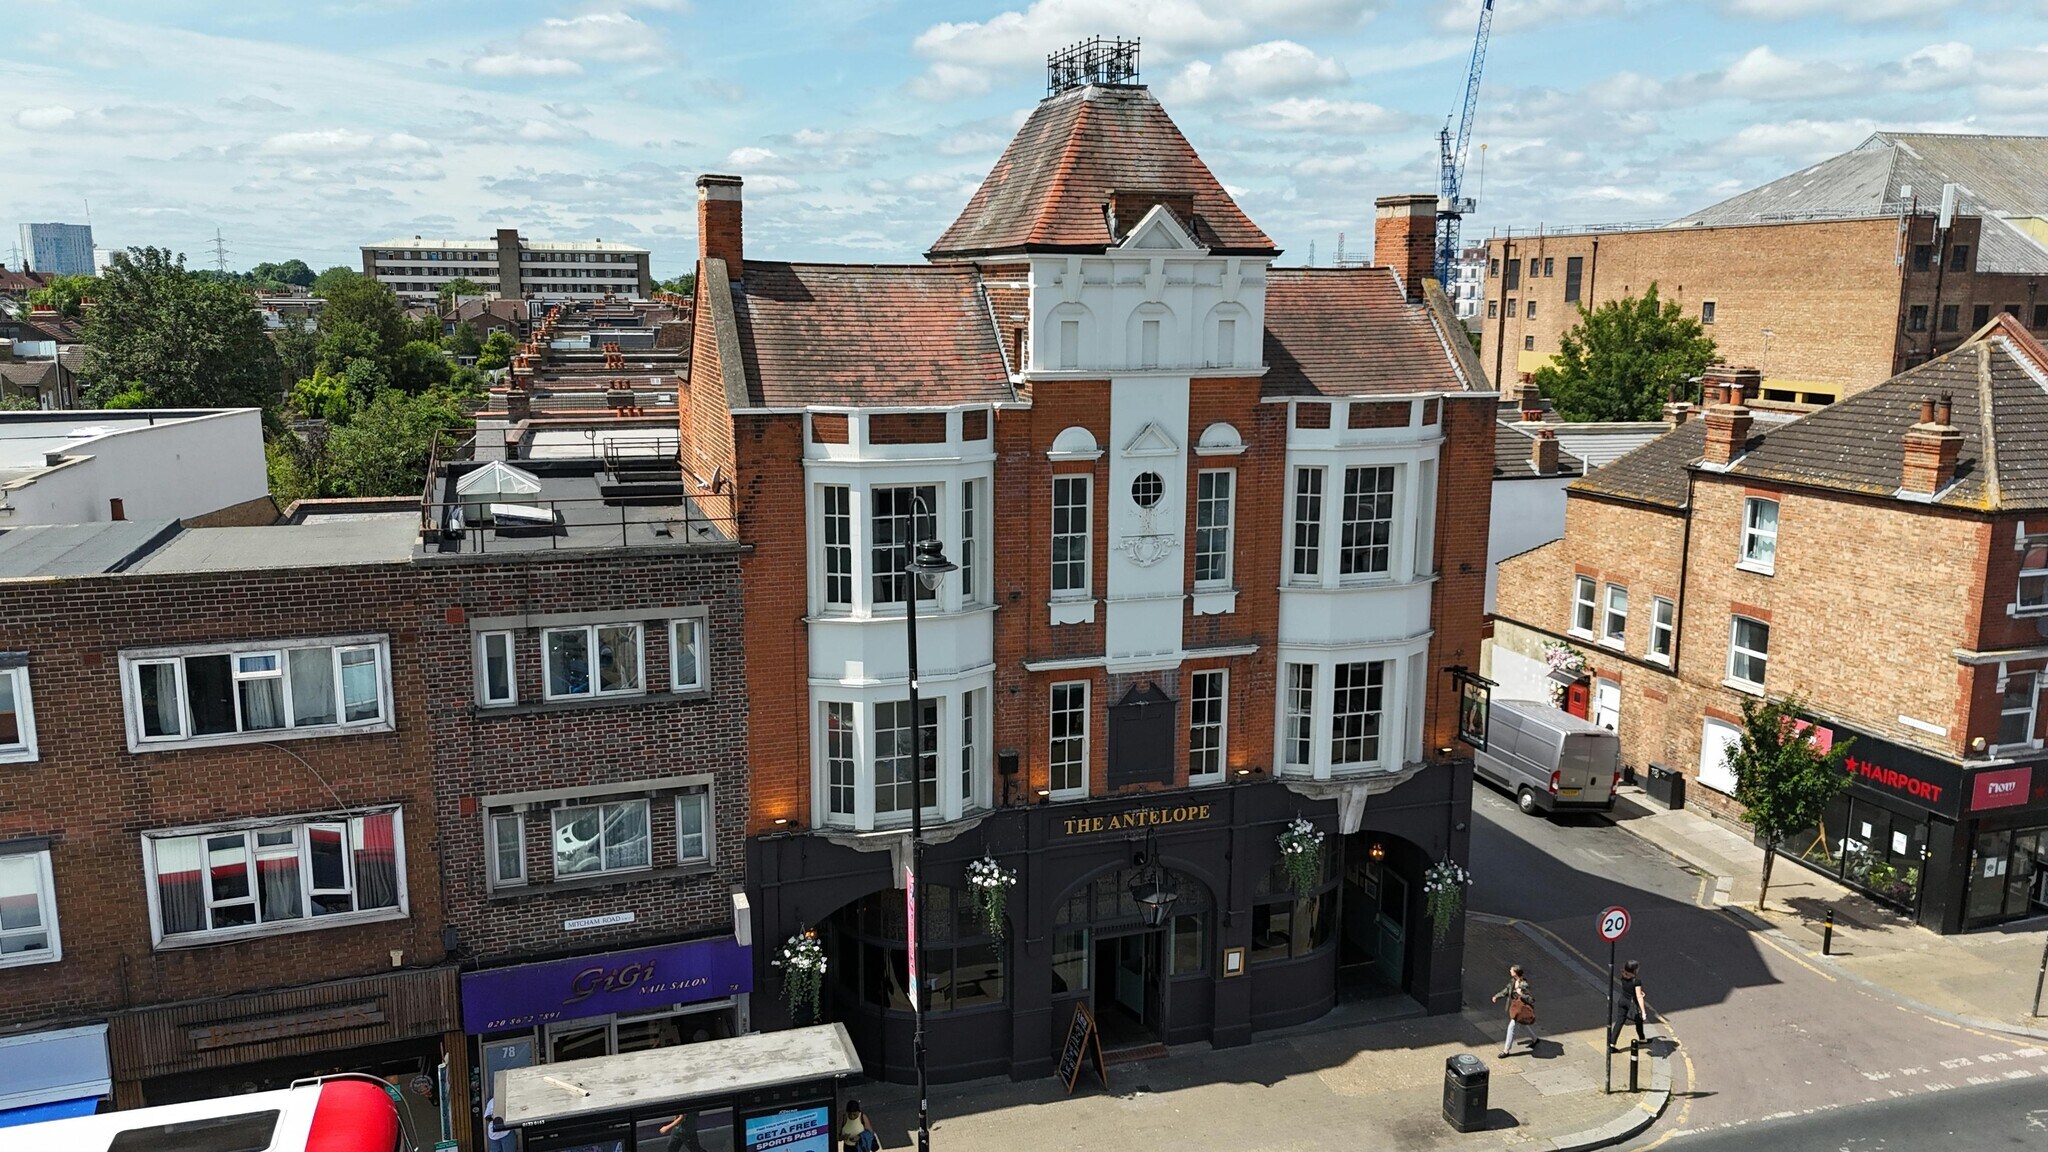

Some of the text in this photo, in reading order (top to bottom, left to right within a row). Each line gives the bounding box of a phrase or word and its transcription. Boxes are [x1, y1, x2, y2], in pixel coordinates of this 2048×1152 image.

[1860, 761, 1943, 802] HAIRPORT
[1063, 804, 1211, 835] THE ANTELOPE
[567, 919, 600, 928] MITCHAM
[1604, 916, 1625, 932] 20
[562, 959, 656, 1005] GiGi
[638, 977, 709, 995] NAIL SALON
[487, 1019, 506, 1028] 020
[509, 1015, 534, 1025] 8672
[502, 1046, 516, 1059] 78
[756, 1129, 780, 1141] GET
[780, 1127, 788, 1135] A
[789, 1119, 818, 1133] FREE
[756, 1129, 818, 1151] SPORTS PASS
